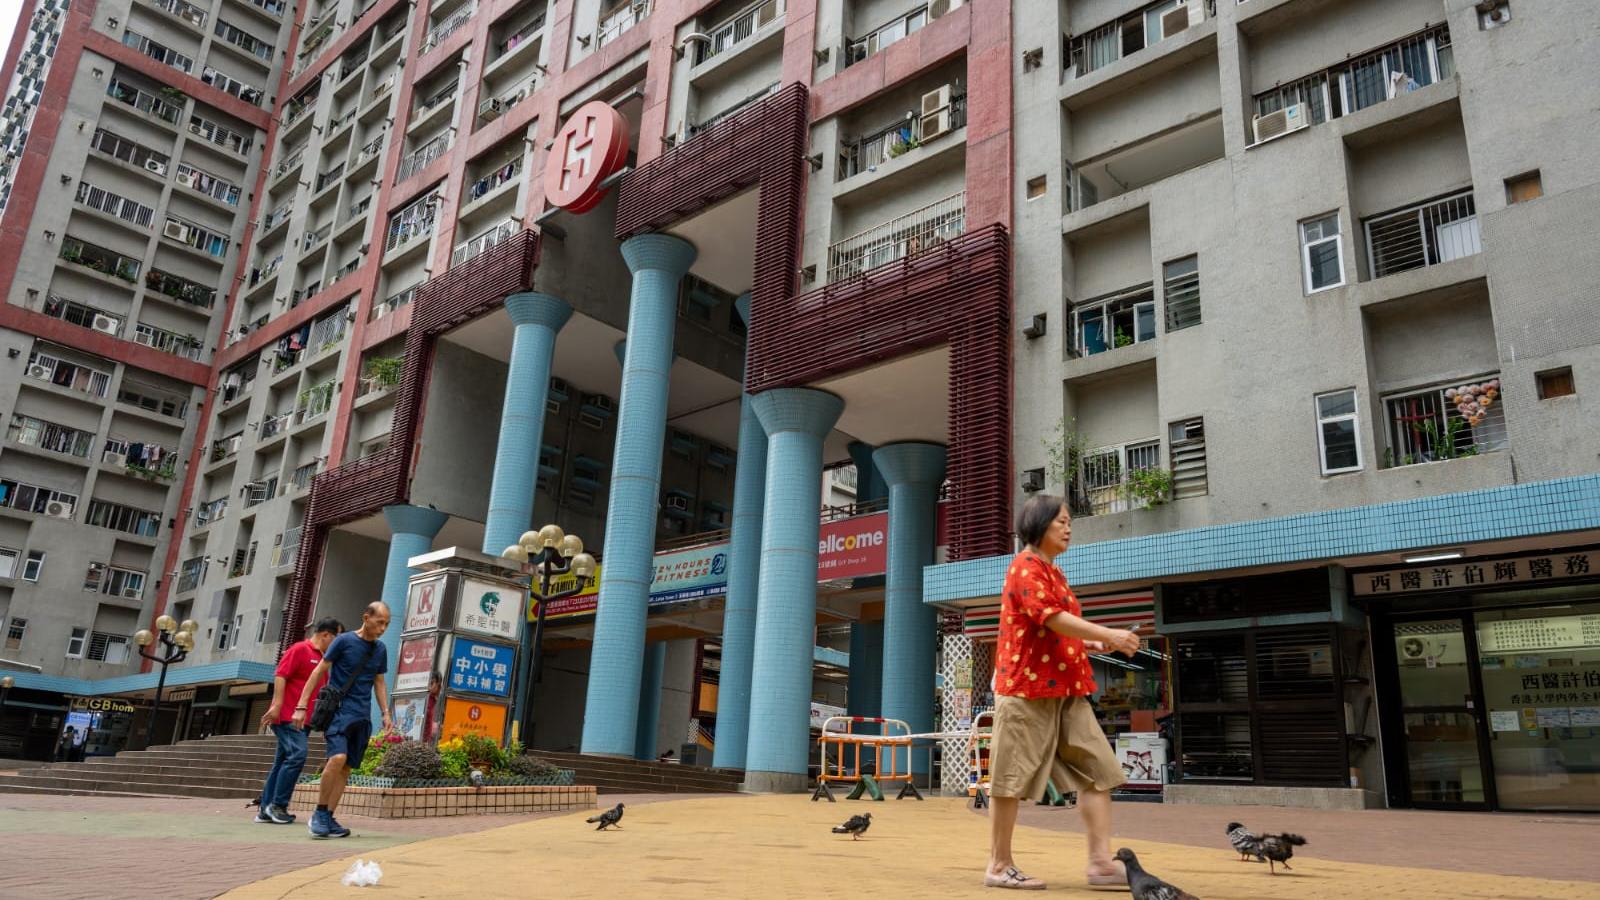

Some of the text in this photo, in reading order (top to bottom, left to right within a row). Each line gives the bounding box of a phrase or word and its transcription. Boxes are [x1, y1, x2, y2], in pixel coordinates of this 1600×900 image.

[675, 558, 711, 570] HOURS
[656, 568, 709, 583] FITNESS
[1370, 555, 1590, 592] 西醫許伯輝醫務
[411, 617, 429, 628] Circle
[455, 656, 507, 678] 中小學
[453, 673, 506, 692] 專科補習
